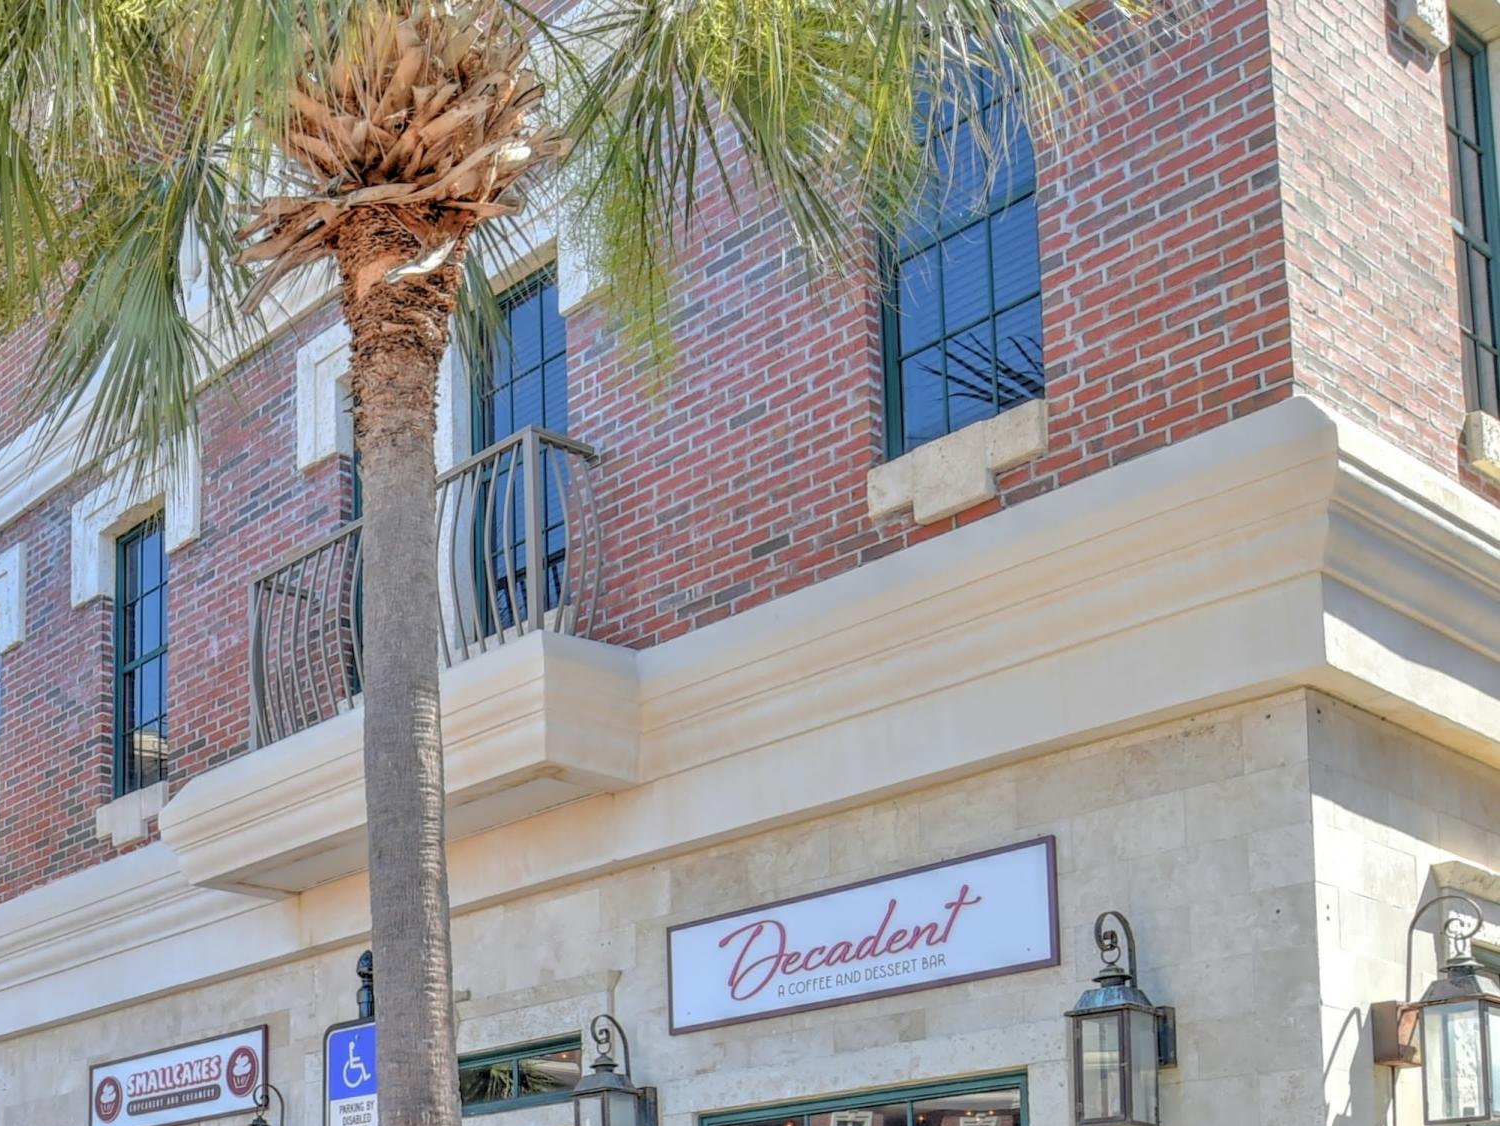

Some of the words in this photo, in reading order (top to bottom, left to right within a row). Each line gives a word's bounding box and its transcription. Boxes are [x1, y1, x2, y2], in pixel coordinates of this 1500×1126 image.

[718, 884, 982, 1001] Decadent
[777, 985, 786, 998] A
[788, 975, 833, 996] COFFEE
[836, 970, 862, 987] AND
[865, 958, 917, 982] DESSERT
[921, 953, 947, 970] BAR
[126, 1055, 222, 1098] SMALLCAKES
[167, 1096, 179, 1106] AND
[182, 1088, 216, 1103] CREAMERY
[339, 1102, 365, 1114] PARKING
[366, 1100, 375, 1111] BY
[342, 1113, 372, 1126] DISABLED
